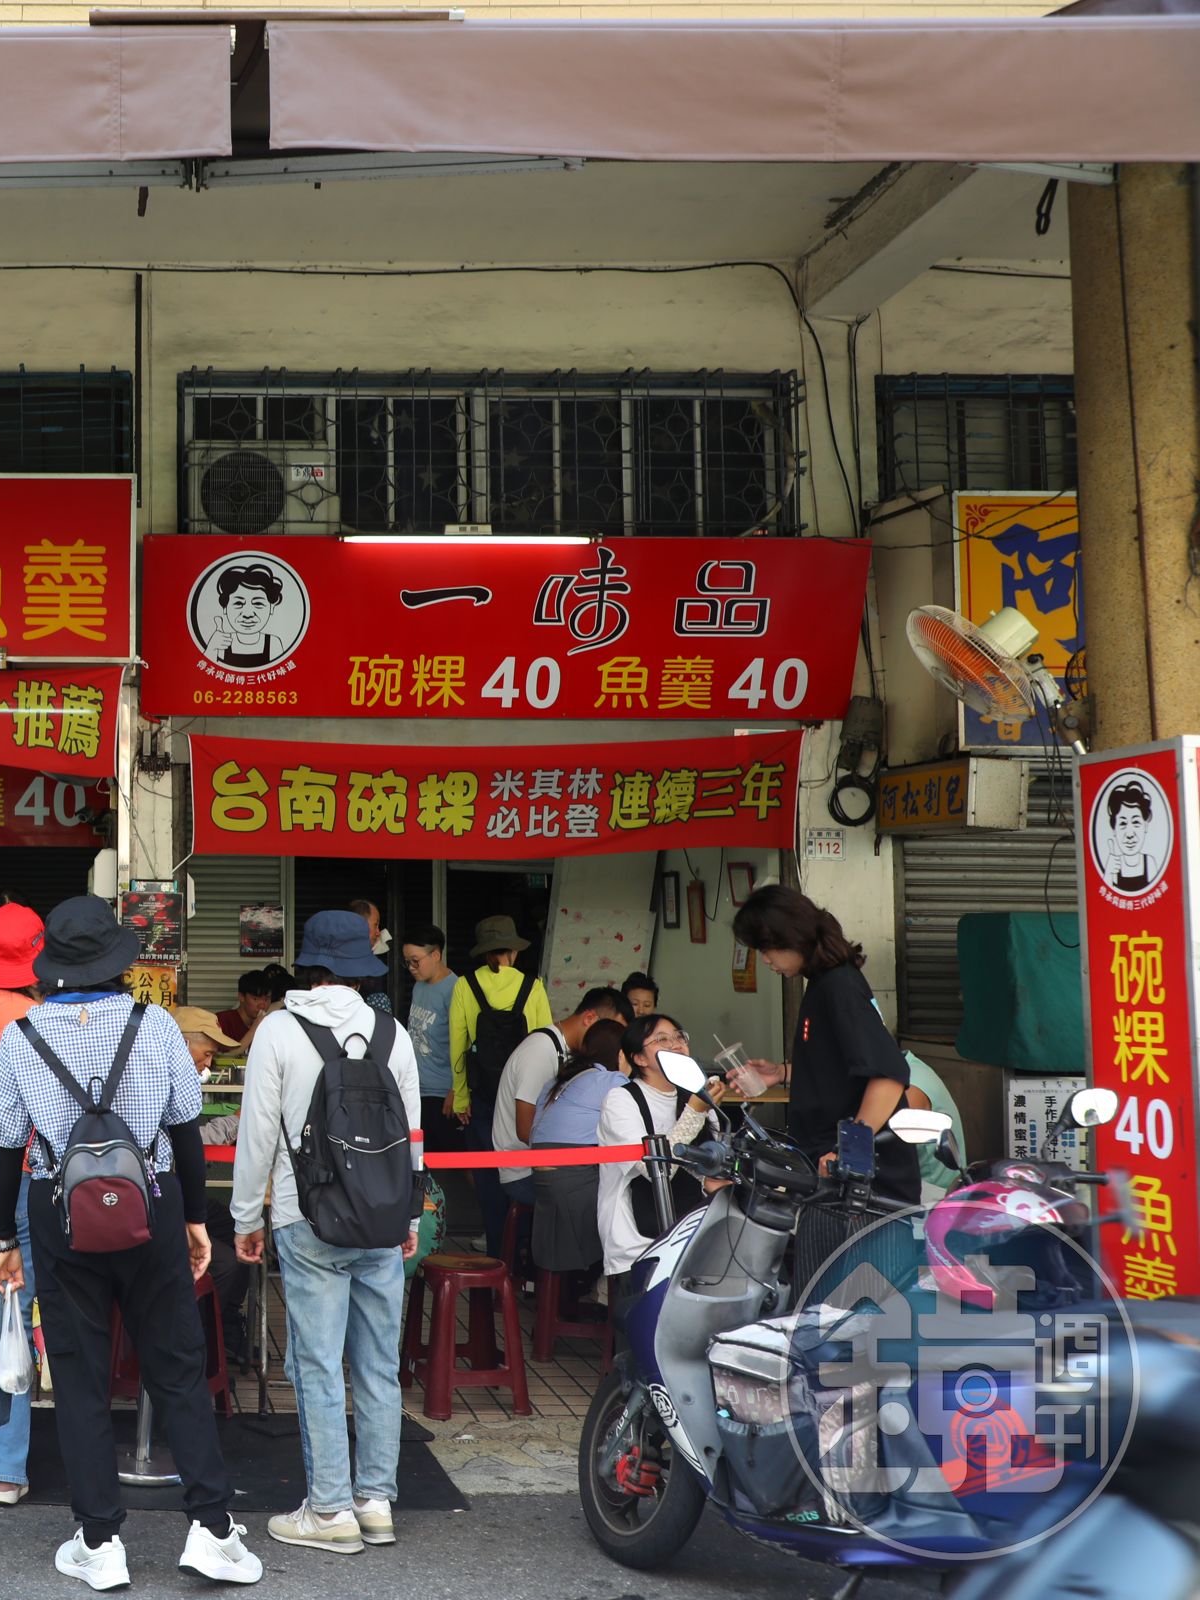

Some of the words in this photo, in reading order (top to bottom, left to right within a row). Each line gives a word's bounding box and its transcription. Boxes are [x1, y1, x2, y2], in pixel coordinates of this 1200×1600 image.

[399, 546, 772, 657] 一味品
[193, 690, 298, 704] 06-2288563
[196, 659, 297, 686] 傳承吳師傅三代好味道
[347, 653, 466, 709] 碗粿
[481, 656, 561, 710] 40
[594, 655, 712, 710] 魚羹
[727, 657, 809, 710] 40
[14, 776, 87, 827] 40
[210, 760, 479, 836] 台南碗粿
[489, 768, 604, 800] 米其林
[608, 762, 785, 829] 連續三年
[880, 774, 965, 822] 阿松割包
[486, 803, 601, 839] 必比登
[818, 842, 840, 854] 112
[136, 953, 181, 961] 位的支持與肯定
[1109, 930, 1170, 1086] 碗粿
[1013, 1095, 1027, 1158] 濃情蜜茶
[1115, 1096, 1174, 1160] 40
